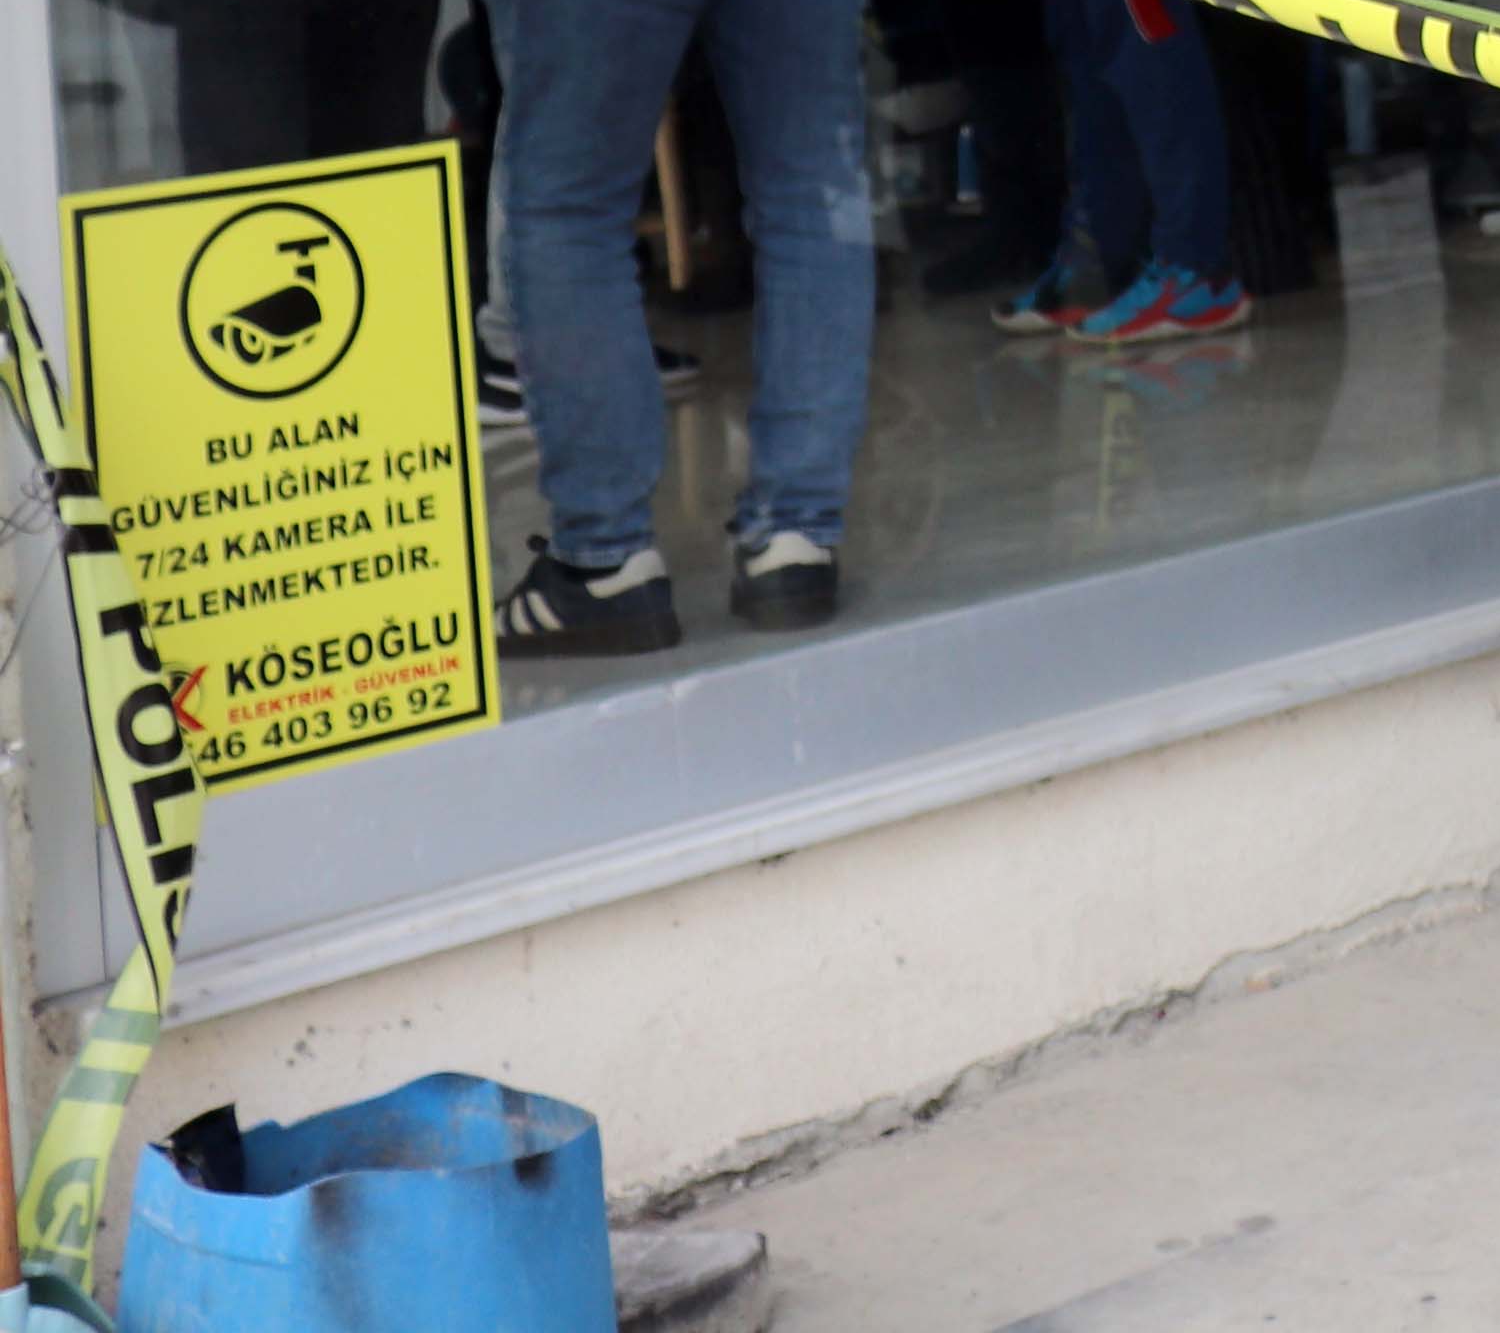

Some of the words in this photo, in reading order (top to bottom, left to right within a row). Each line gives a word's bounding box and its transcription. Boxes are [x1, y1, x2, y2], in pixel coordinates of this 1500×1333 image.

[206, 433, 253, 466] BU
[266, 412, 360, 454] ALAN
[110, 457, 372, 534] GÜVENLİĞİNİZ
[384, 441, 454, 482] İÇİN
[136, 540, 210, 581] 7/24
[223, 508, 372, 563] KAMERA
[384, 494, 437, 528] İLE
[225, 610, 460, 698] KÖSEOĞLU
[227, 685, 336, 725] ELEKTRİK
[354, 653, 462, 695] GÜVENLİK
[187, 734, 248, 766] 46
[261, 709, 335, 749] 403
[347, 693, 395, 732] 96
[406, 682, 453, 716] 92
[98, 600, 198, 955] POL
